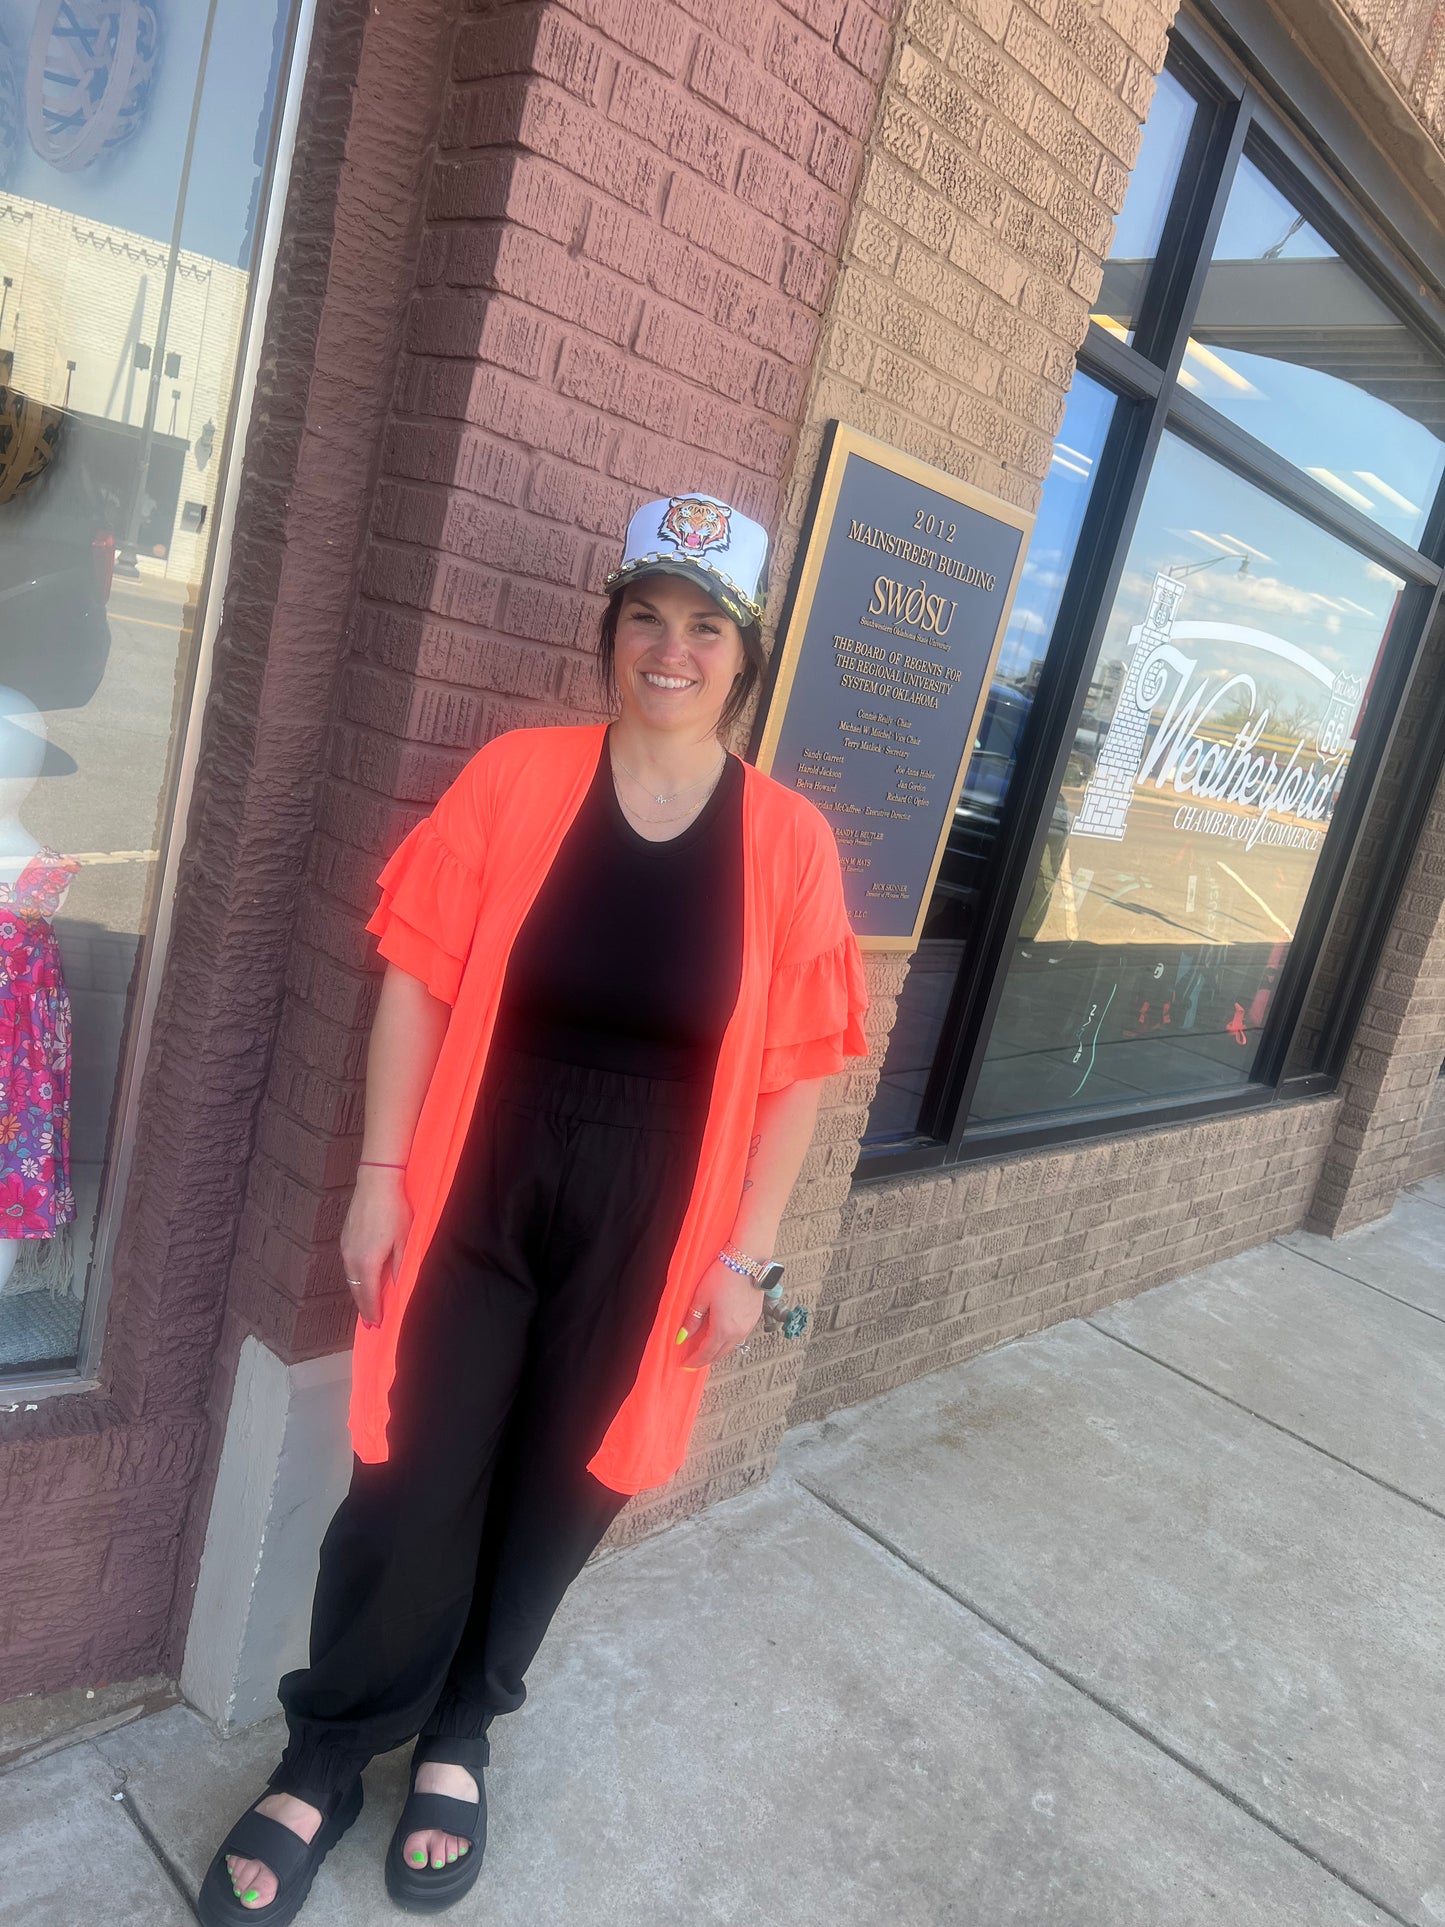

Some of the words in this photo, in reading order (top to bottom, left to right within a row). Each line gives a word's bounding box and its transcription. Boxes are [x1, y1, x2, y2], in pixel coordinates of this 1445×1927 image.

[913, 510, 957, 543] 2012
[848, 519, 938, 570] MAINSTREET
[938, 555, 996, 592] BUILDING
[860, 616, 893, 634] Southwestern
[893, 627, 916, 641] Oklahoma
[916, 634, 929, 645] State
[929, 638, 951, 652] University
[833, 635, 852, 652] THE
[854, 641, 886, 661] BOARD
[888, 651, 902, 664] OF
[903, 655, 942, 677] REGENTS
[944, 667, 962, 682] FOR
[835, 654, 855, 670] THE
[856, 659, 901, 682] REGIONAL
[902, 672, 953, 695] UNIVERSITY
[841, 674, 878, 694] SYSTEM
[878, 683, 893, 697] OF
[891, 687, 938, 709] OKLAHOMA
[857, 709, 877, 722] Connie
[896, 717, 912, 728] Chair
[1334, 704, 1347, 720] US
[839, 720, 862, 733] Michael
[895, 731, 906, 743] Vice
[906, 735, 921, 746] Chair
[1136, 643, 1347, 851] Weatherford
[1321, 720, 1343, 755] 66
[803, 748, 822, 761] Sandy
[823, 752, 845, 763] Garrett
[844, 737, 860, 750] Terry
[884, 746, 910, 759] Secretary
[798, 763, 819, 775] Harold
[820, 767, 842, 779] Jackson
[796, 779, 813, 789] Belva
[814, 781, 837, 793] Howard
[886, 792, 907, 803] Richard
[865, 806, 890, 818] Executive
[890, 810, 911, 820] Director
[1173, 805, 1239, 840] CHAMBER
[1238, 816, 1257, 841] OF
[1261, 820, 1322, 850] COMMERCE
